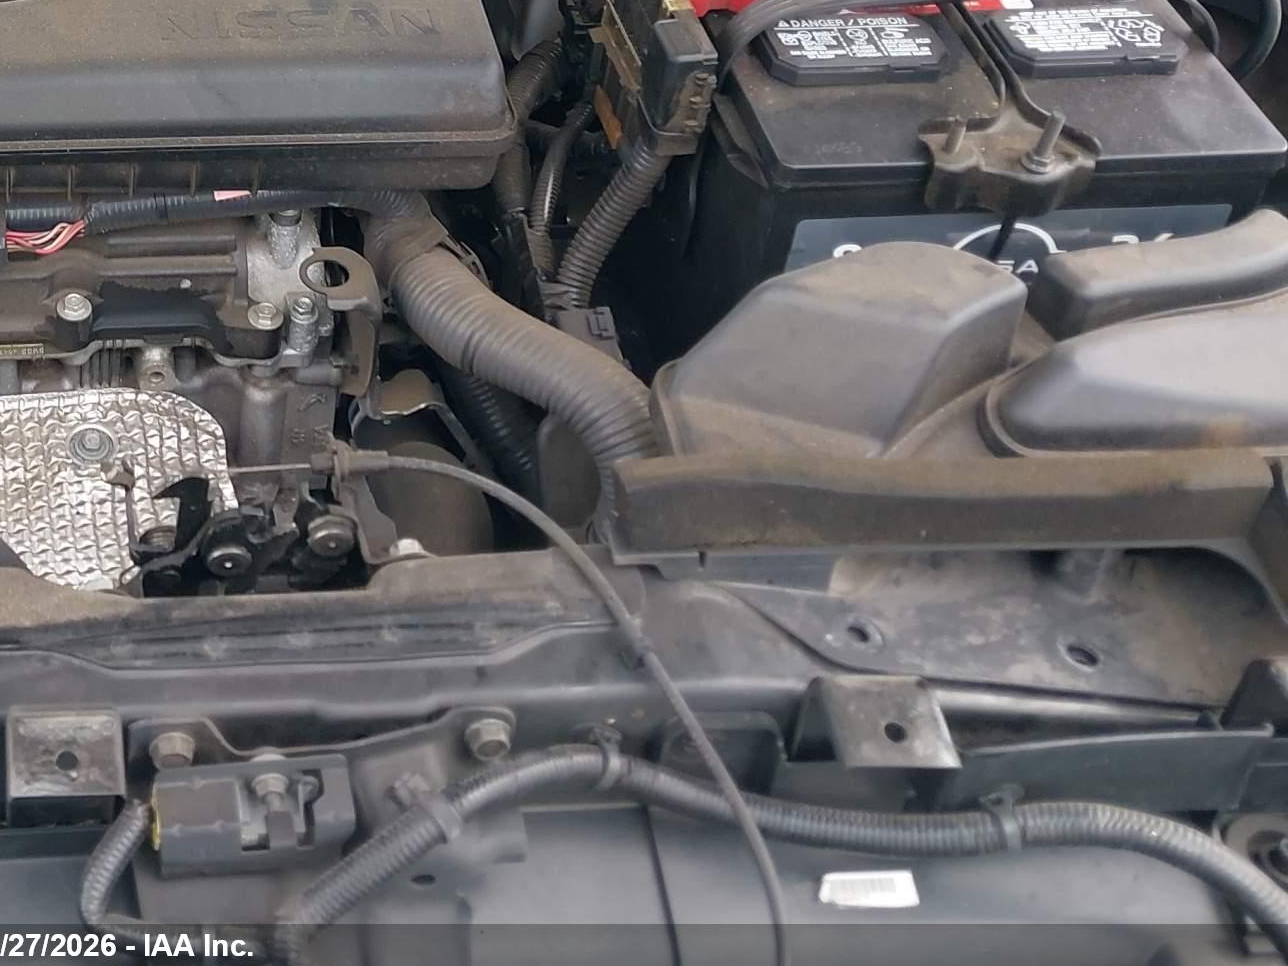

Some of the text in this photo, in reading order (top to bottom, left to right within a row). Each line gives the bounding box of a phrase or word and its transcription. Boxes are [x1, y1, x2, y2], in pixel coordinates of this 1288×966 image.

[161, 2, 442, 41] NISSAN
[789, 19, 846, 28] DANGER
[857, 17, 908, 26] POISON
